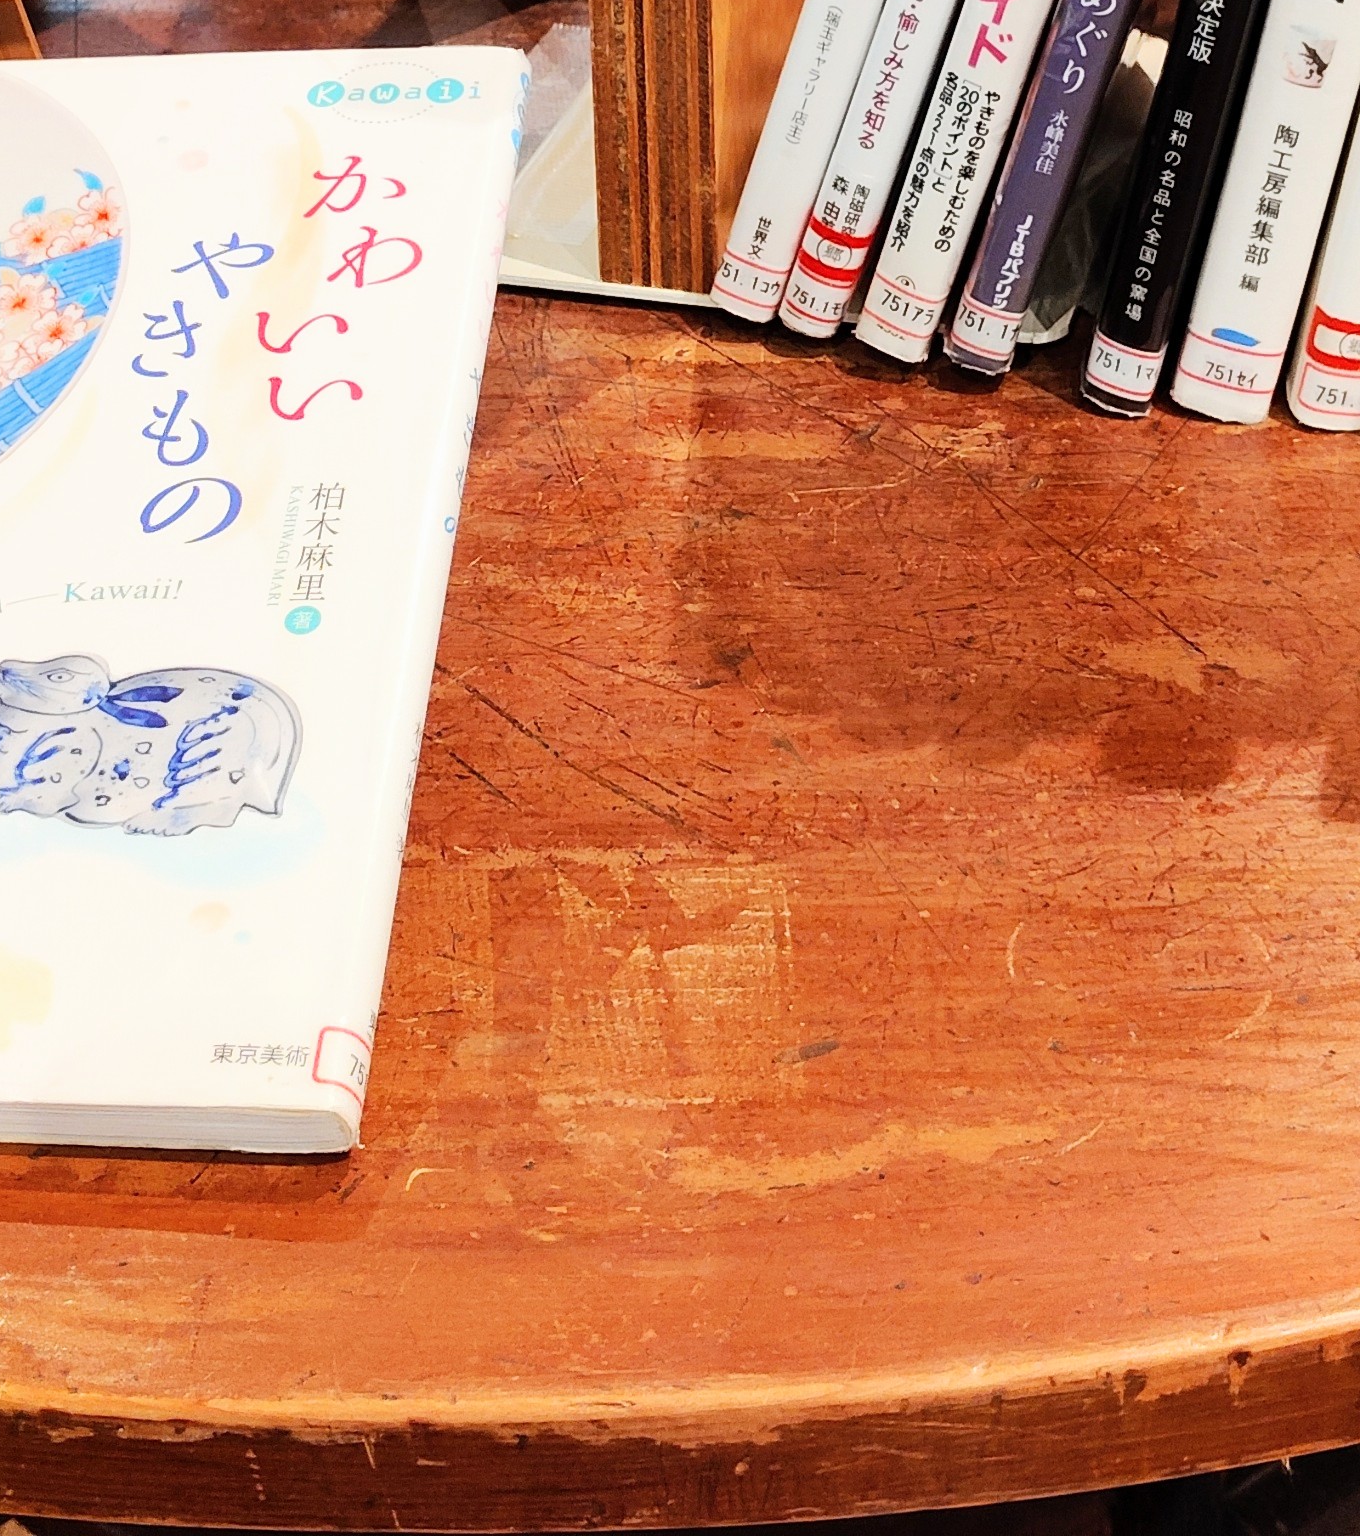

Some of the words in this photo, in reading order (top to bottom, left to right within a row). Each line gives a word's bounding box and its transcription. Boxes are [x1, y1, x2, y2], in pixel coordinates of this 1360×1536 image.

[310, 78, 482, 107] Kawaii
[1244, 124, 1300, 267] 陶工房編集部
[747, 216, 772, 262] 世界文
[256, 155, 424, 422] かわいい
[131, 231, 275, 544] やきもの
[274, 485, 304, 562] KASHIWAGI
[289, 481, 345, 602] 柏木麻里
[266, 565, 284, 608] MARI
[210, 1042, 311, 1070] 東京美術
